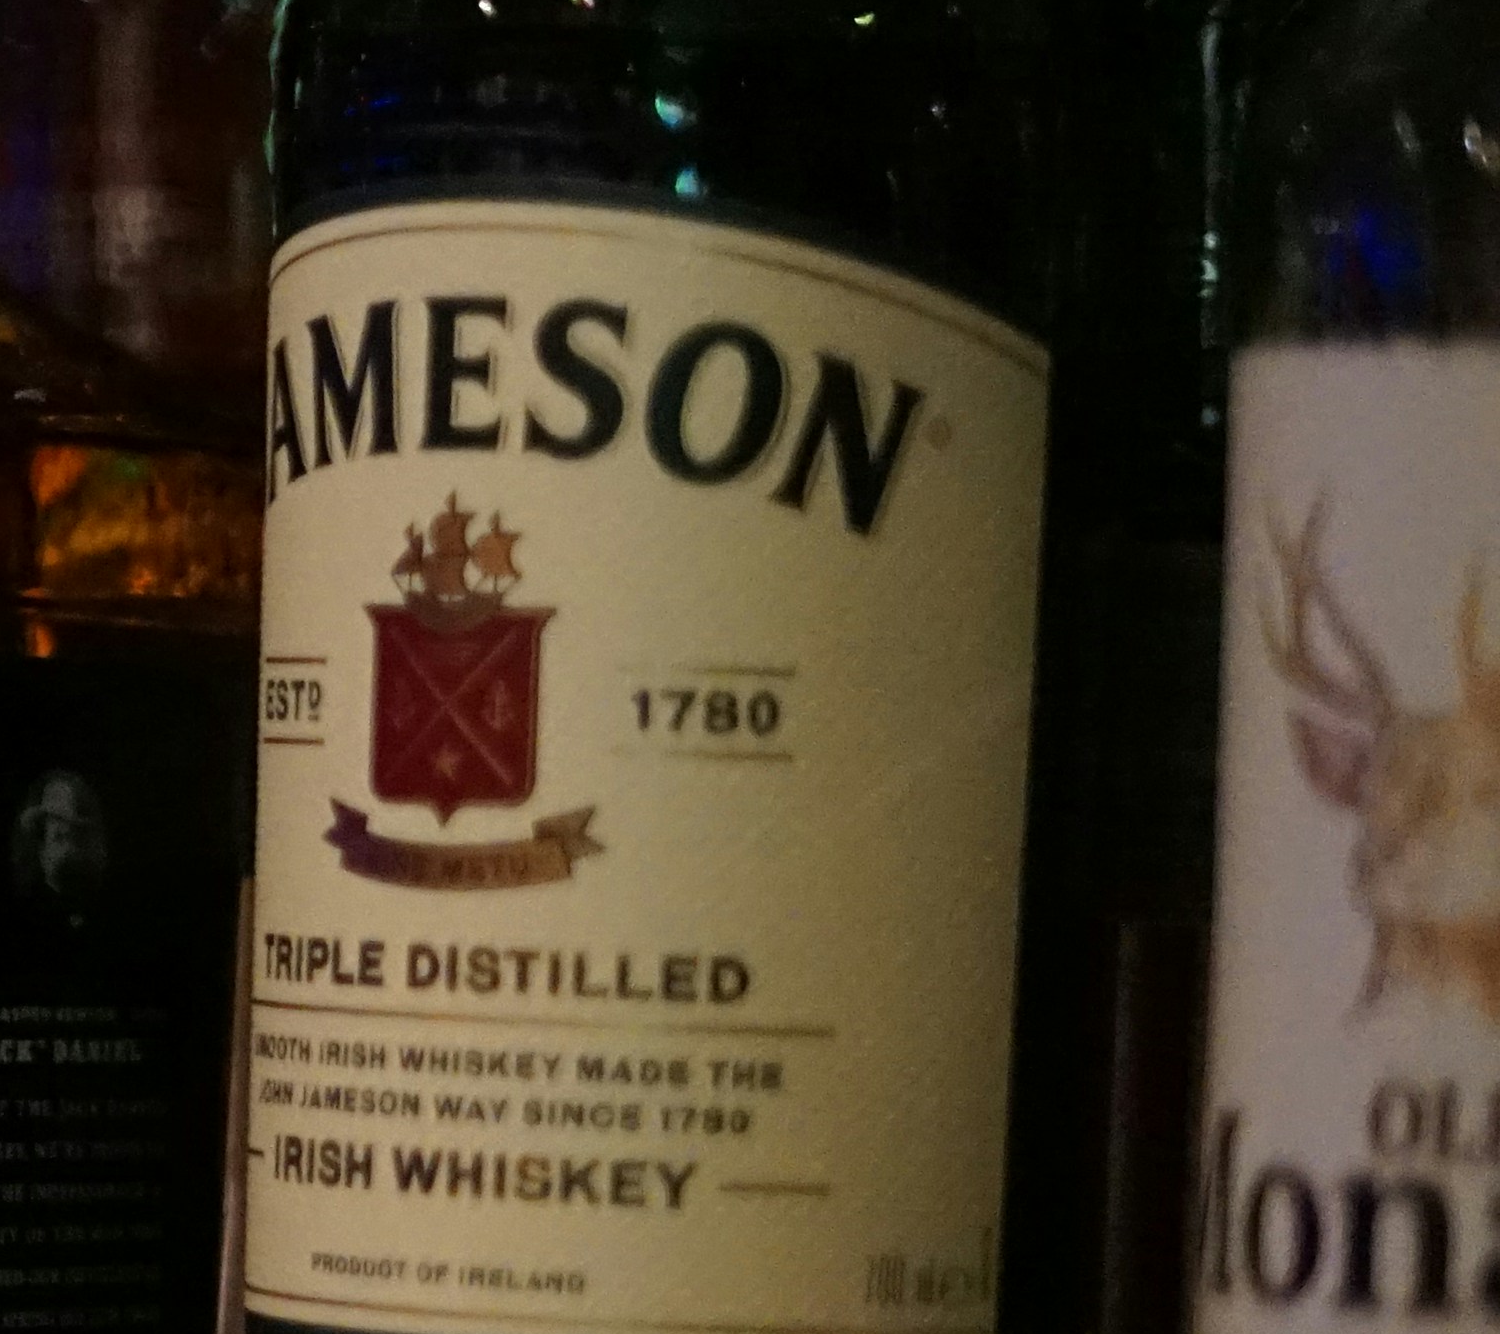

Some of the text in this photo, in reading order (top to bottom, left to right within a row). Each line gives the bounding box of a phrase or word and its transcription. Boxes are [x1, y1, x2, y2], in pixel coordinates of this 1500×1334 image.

[633, 688, 781, 737] 1780
[265, 933, 750, 1003] TRIPLE DISTILLED
[318, 1038, 386, 1069] IRISH
[400, 1046, 561, 1082] WHISKEY
[576, 1055, 690, 1088] MADE
[709, 1061, 784, 1092] THE
[300, 1080, 421, 1117] JAMESON
[434, 1093, 507, 1124] WAY
[523, 1098, 642, 1131] SINCE
[660, 1106, 752, 1135] 1780
[274, 1134, 700, 1211] IRISH WHISKEY
[310, 1251, 586, 1296] PRODUCT OF IRELAND
